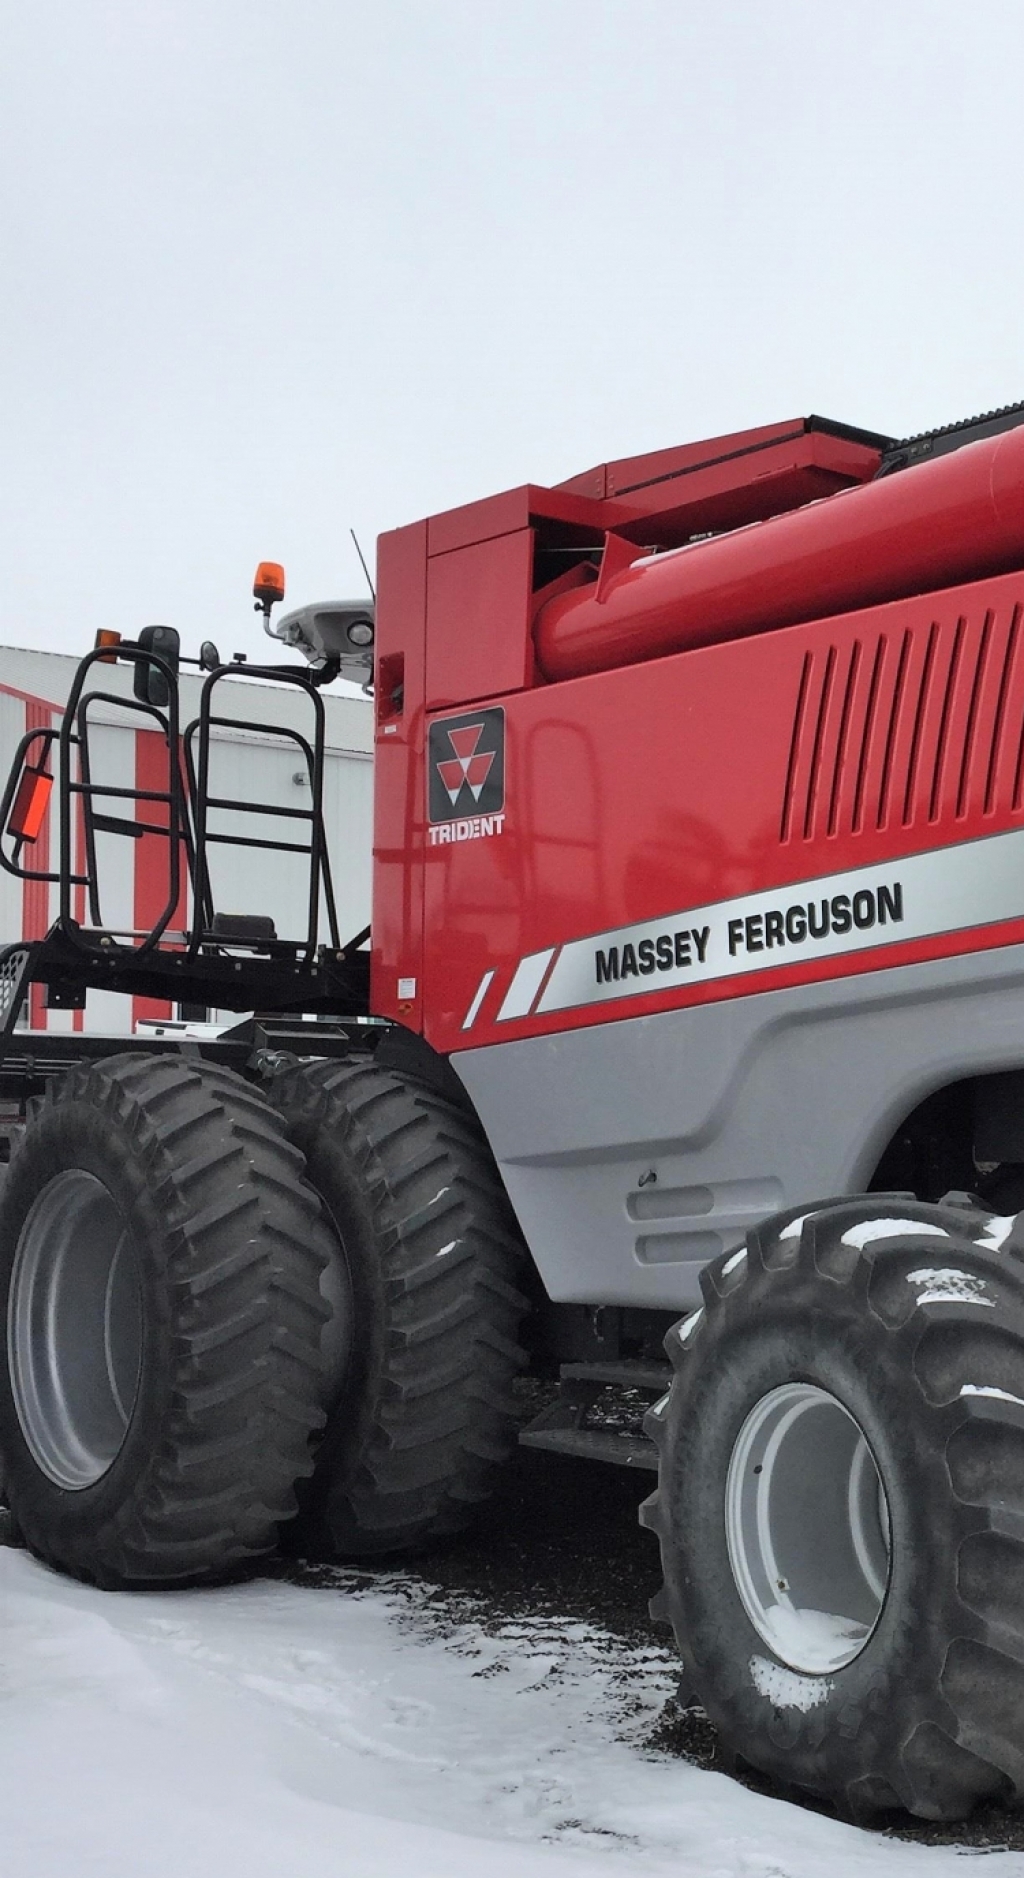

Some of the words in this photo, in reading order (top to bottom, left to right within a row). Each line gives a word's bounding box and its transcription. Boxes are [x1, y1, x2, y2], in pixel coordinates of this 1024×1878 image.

[429, 814, 505, 845] TRIDENT
[595, 926, 710, 984] MASSEY
[728, 883, 904, 956] FERGUSON
